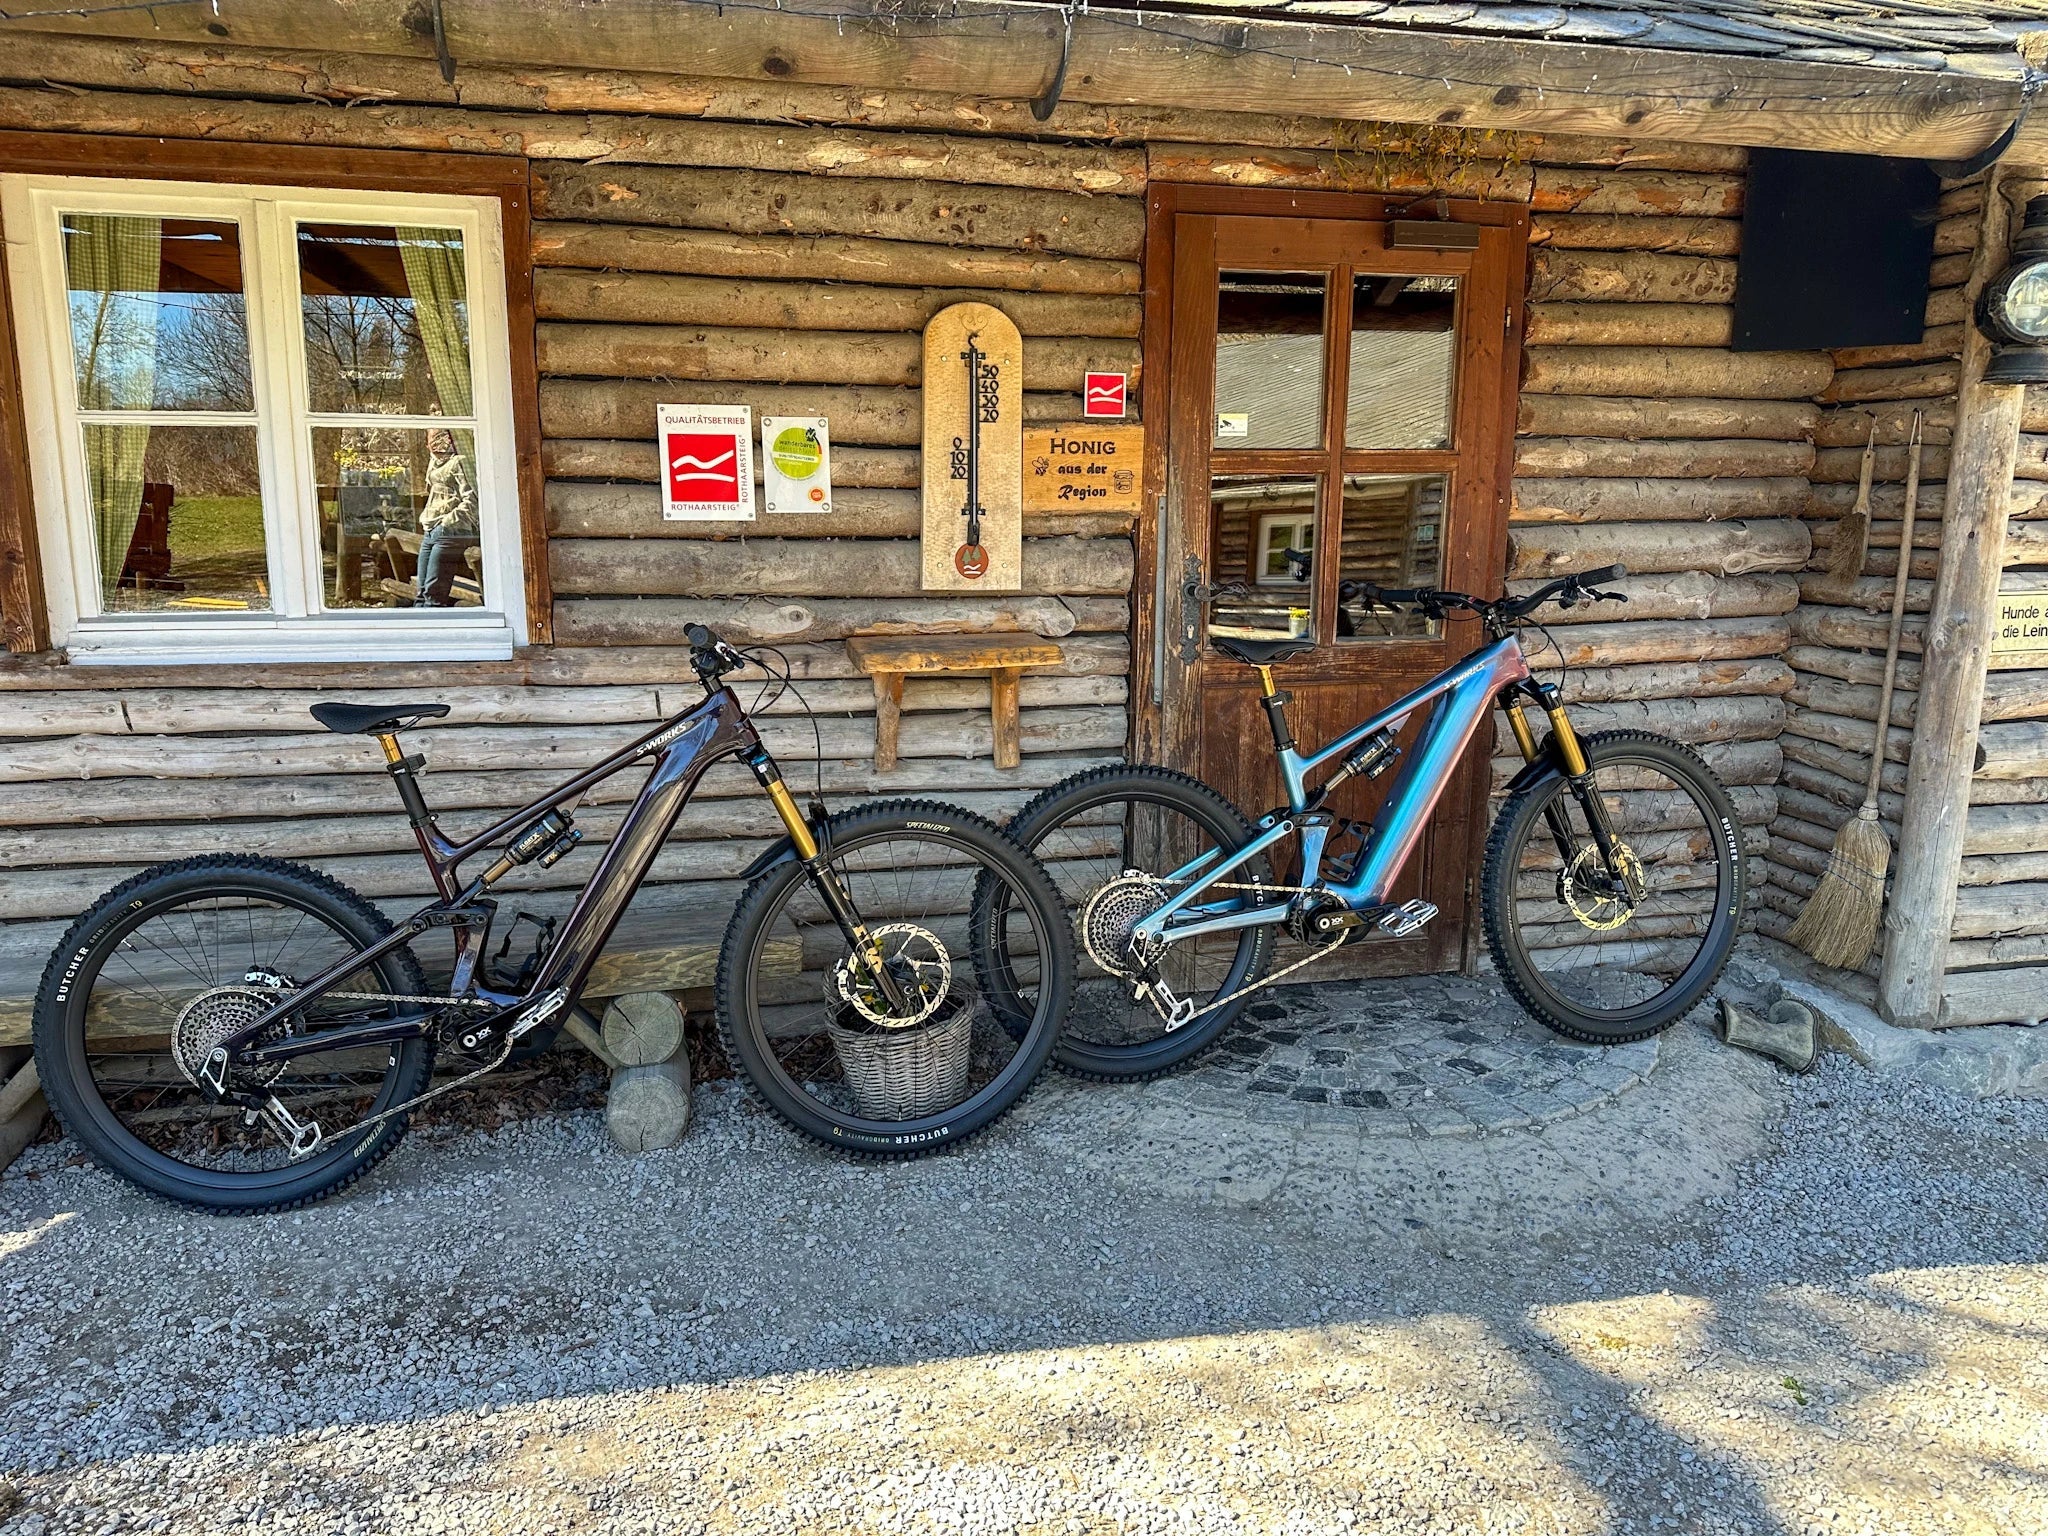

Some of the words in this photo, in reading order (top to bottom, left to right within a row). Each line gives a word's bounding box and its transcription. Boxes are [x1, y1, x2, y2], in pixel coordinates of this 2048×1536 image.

[981, 365, 999, 378] 50
[981, 380, 999, 393] 40
[981, 395, 999, 407] 30
[665, 414, 746, 425] QUALITÄTSBETRIEB
[982, 408, 999, 421] 20
[953, 437, 963, 450] 0
[950, 451, 966, 464] 10
[950, 466, 966, 479] 20
[1058, 465, 1082, 475] aus
[1086, 462, 1108, 475] der
[1058, 484, 1107, 500] Region
[2002, 605, 2039, 620] Hunde
[2002, 625, 2019, 638] die
[2022, 623, 2048, 637] Lein
[636, 722, 687, 757] S-WORKS
[906, 821, 951, 833] SPECIALIZED
[1721, 817, 1738, 861] BUTCHER
[56, 946, 90, 1002] BUTCHER
[895, 1127, 949, 1145] BUTCHER
